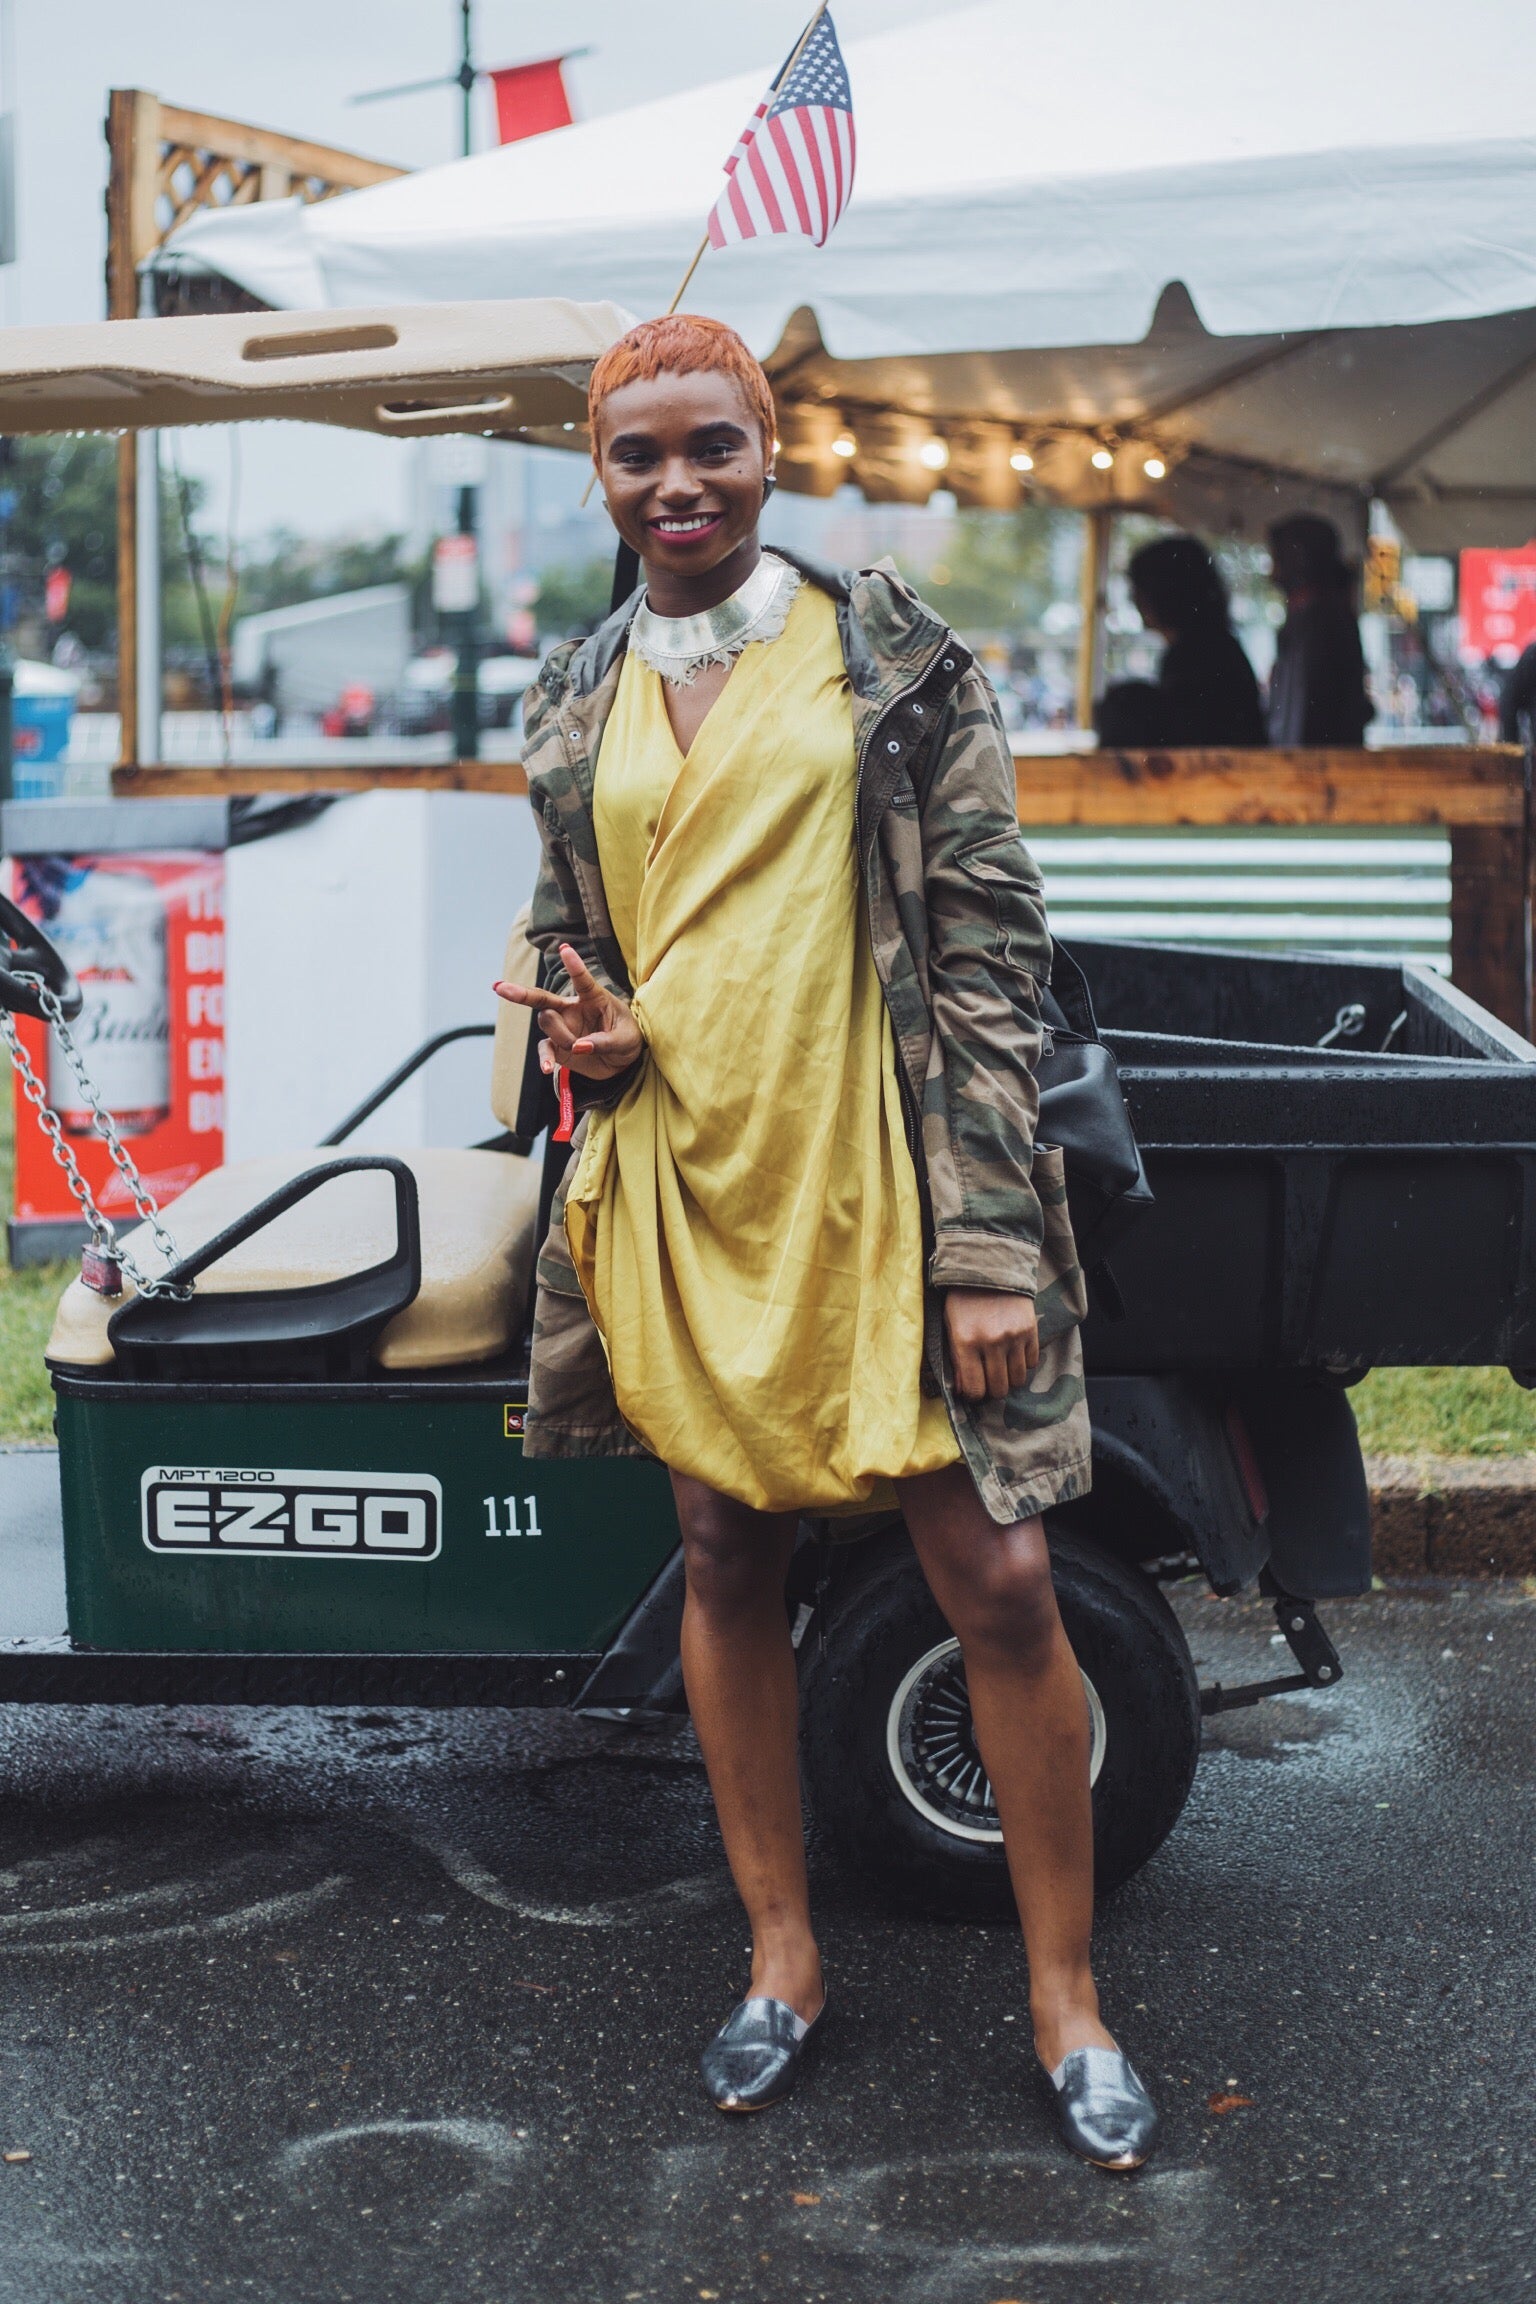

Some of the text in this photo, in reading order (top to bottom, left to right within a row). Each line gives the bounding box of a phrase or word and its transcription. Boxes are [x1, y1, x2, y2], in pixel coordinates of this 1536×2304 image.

[159, 1469, 275, 1482] MPT 1200
[156, 1490, 426, 1549] EZGO
[483, 1495, 542, 1537] 111
